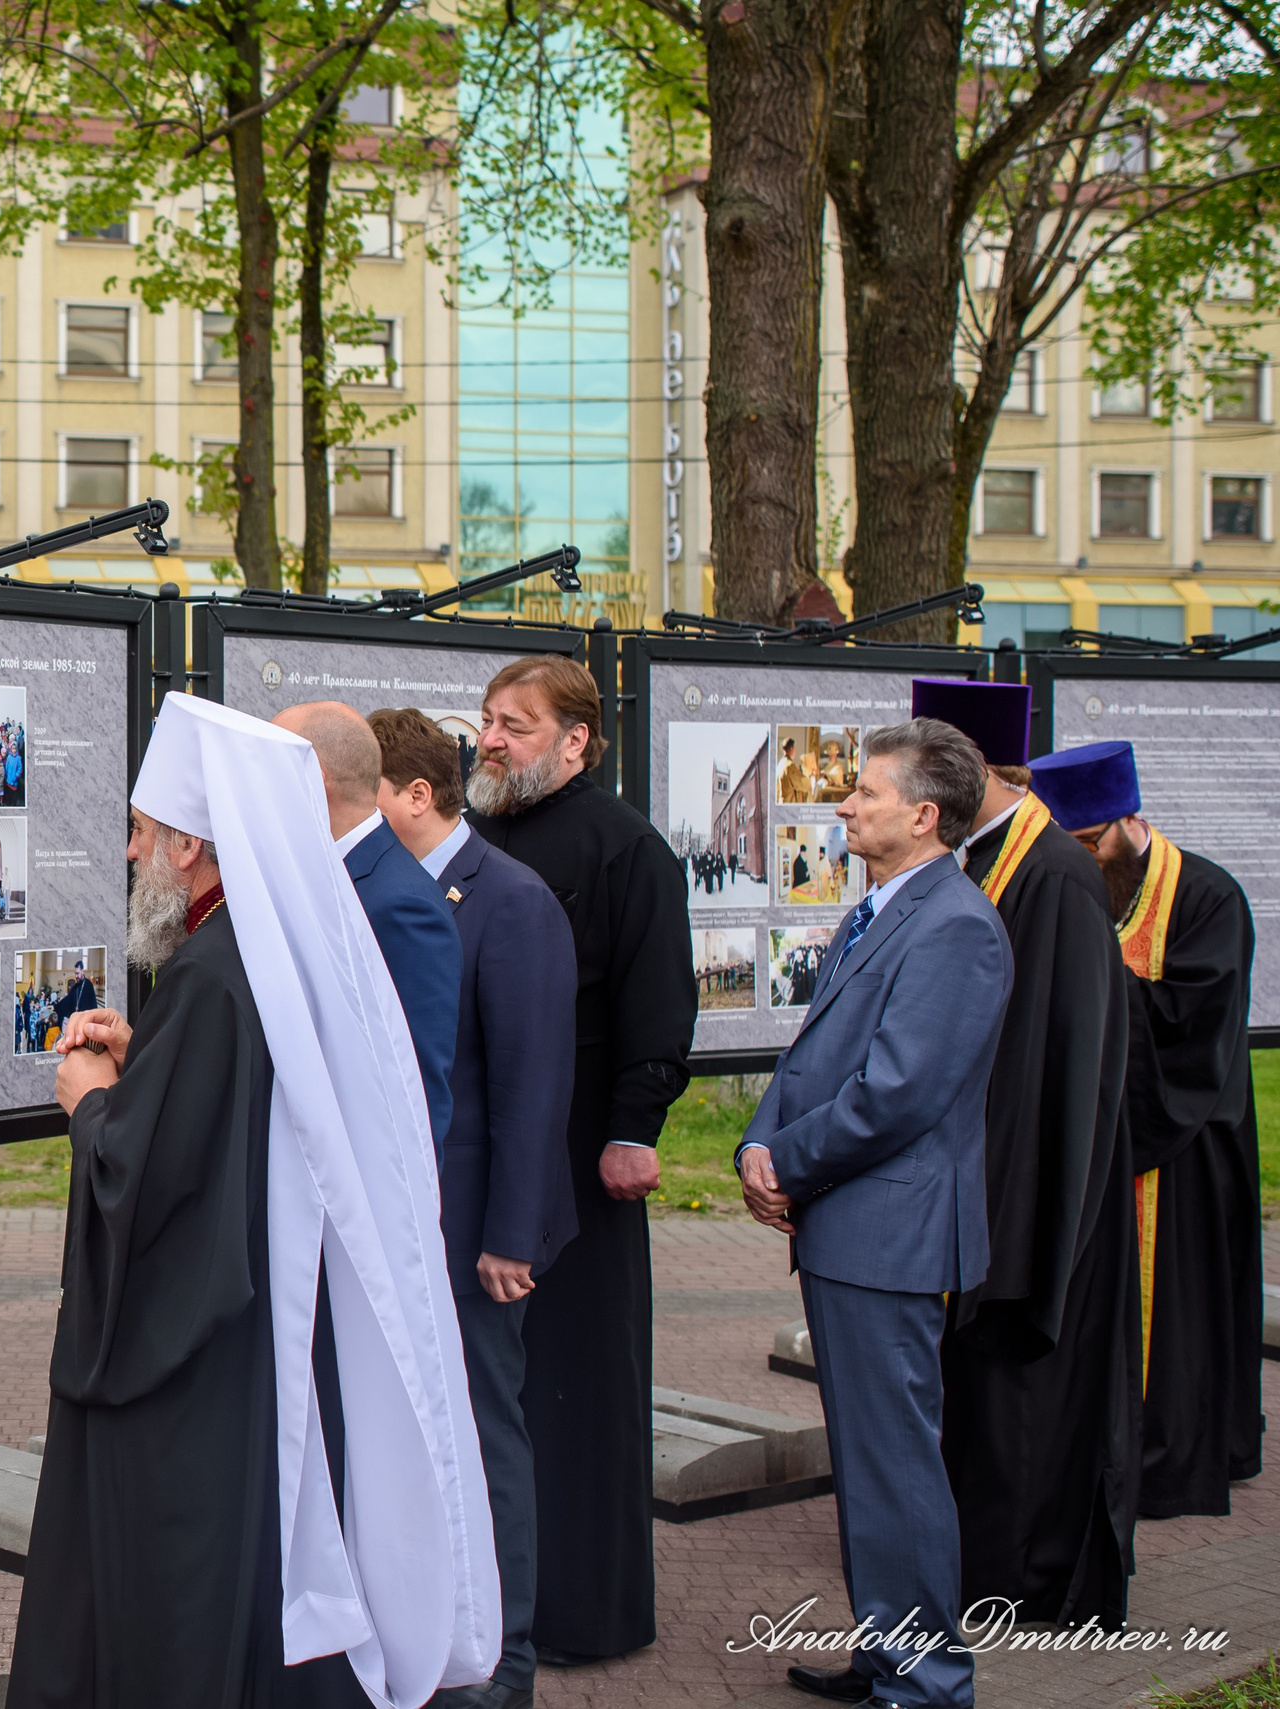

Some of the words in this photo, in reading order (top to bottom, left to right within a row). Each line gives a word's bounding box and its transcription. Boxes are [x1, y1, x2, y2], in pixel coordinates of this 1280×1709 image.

[22, 658, 49, 671] земле
[52, 658, 97, 674] 1985-2025
[288, 672, 300, 684] 40
[303, 676, 320, 685] лет
[323, 673, 378, 689] Православия
[380, 680, 391, 689] на
[393, 677, 464, 694] Калининградской
[708, 693, 719, 705] 40
[721, 697, 737, 706] лет
[739, 694, 791, 708] Православия
